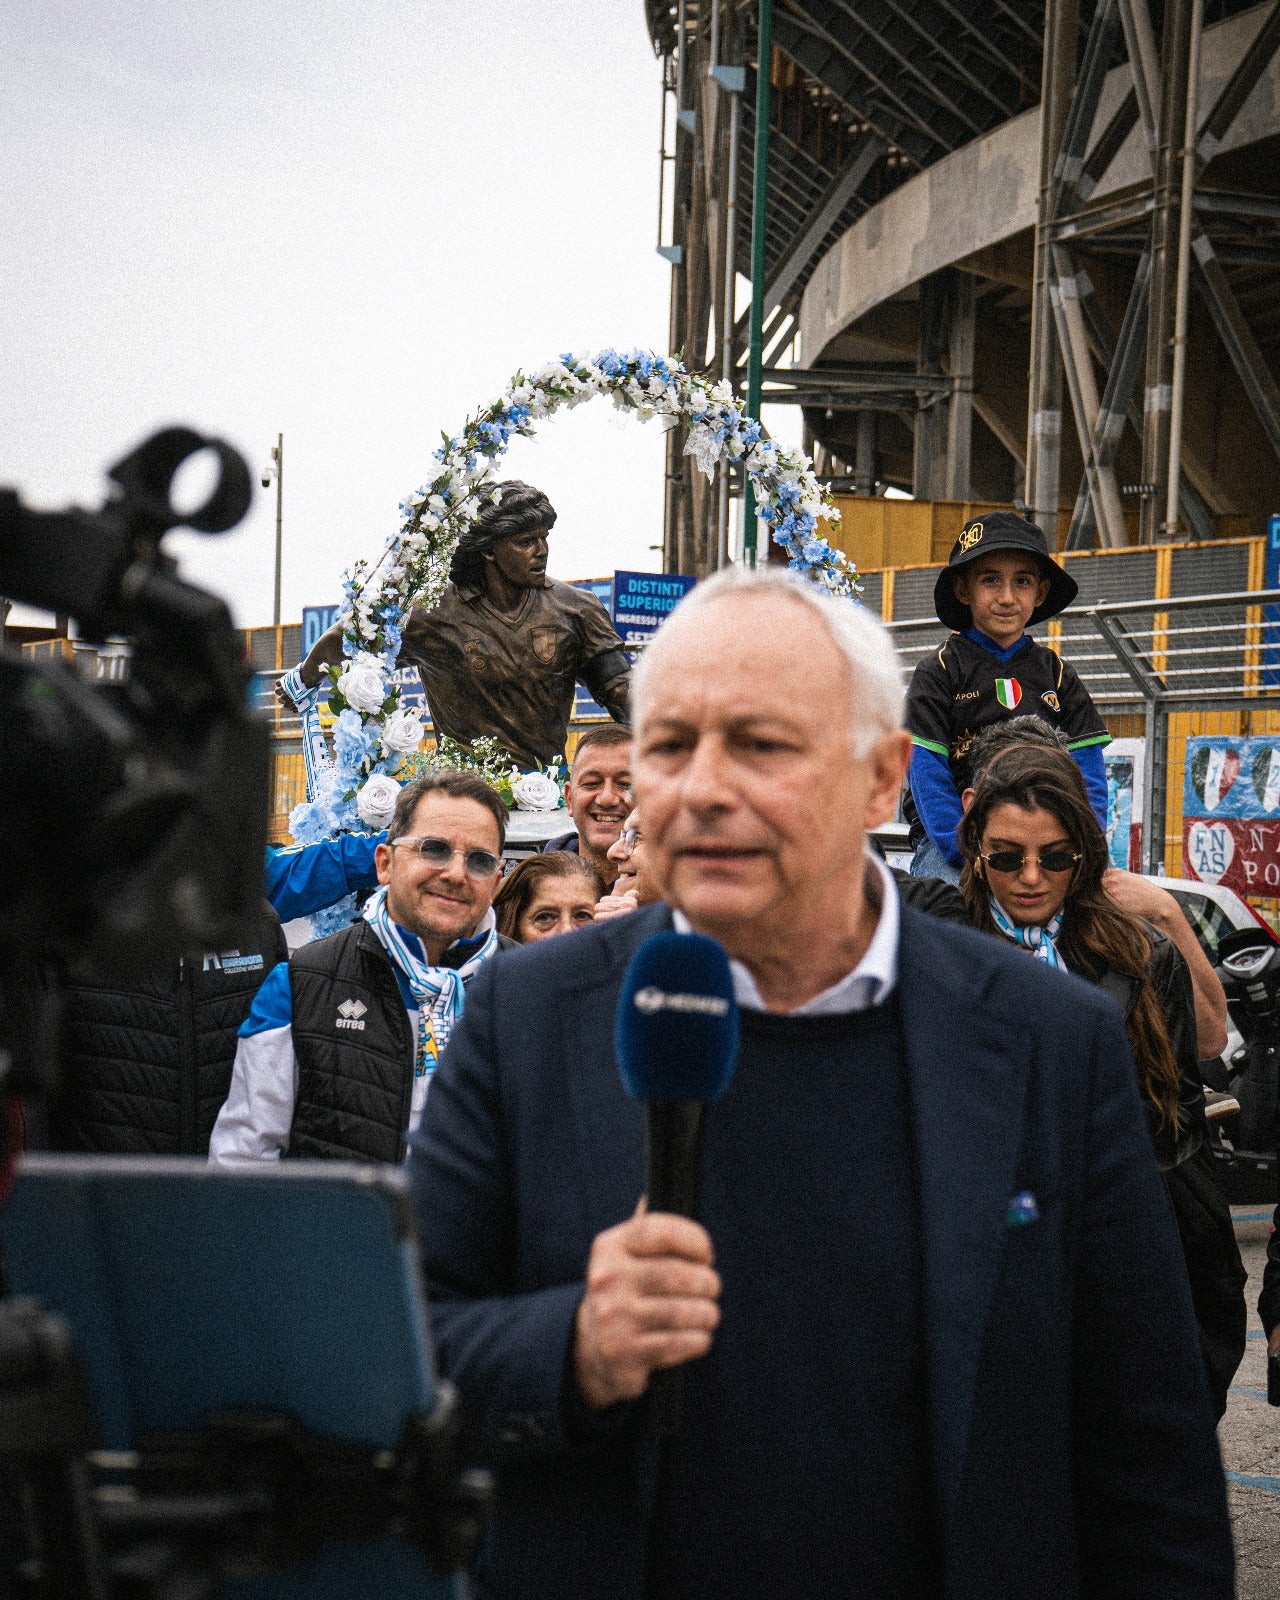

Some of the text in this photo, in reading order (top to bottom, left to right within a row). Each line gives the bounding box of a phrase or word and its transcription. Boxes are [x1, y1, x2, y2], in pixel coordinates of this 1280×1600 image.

[628, 580, 684, 596] DISTINTI
[615, 613, 658, 626] INGRESSO
[1195, 829, 1226, 853] FN
[1249, 828, 1280, 852] N
[1199, 852, 1225, 875] AS
[335, 1018, 366, 1031] errea
